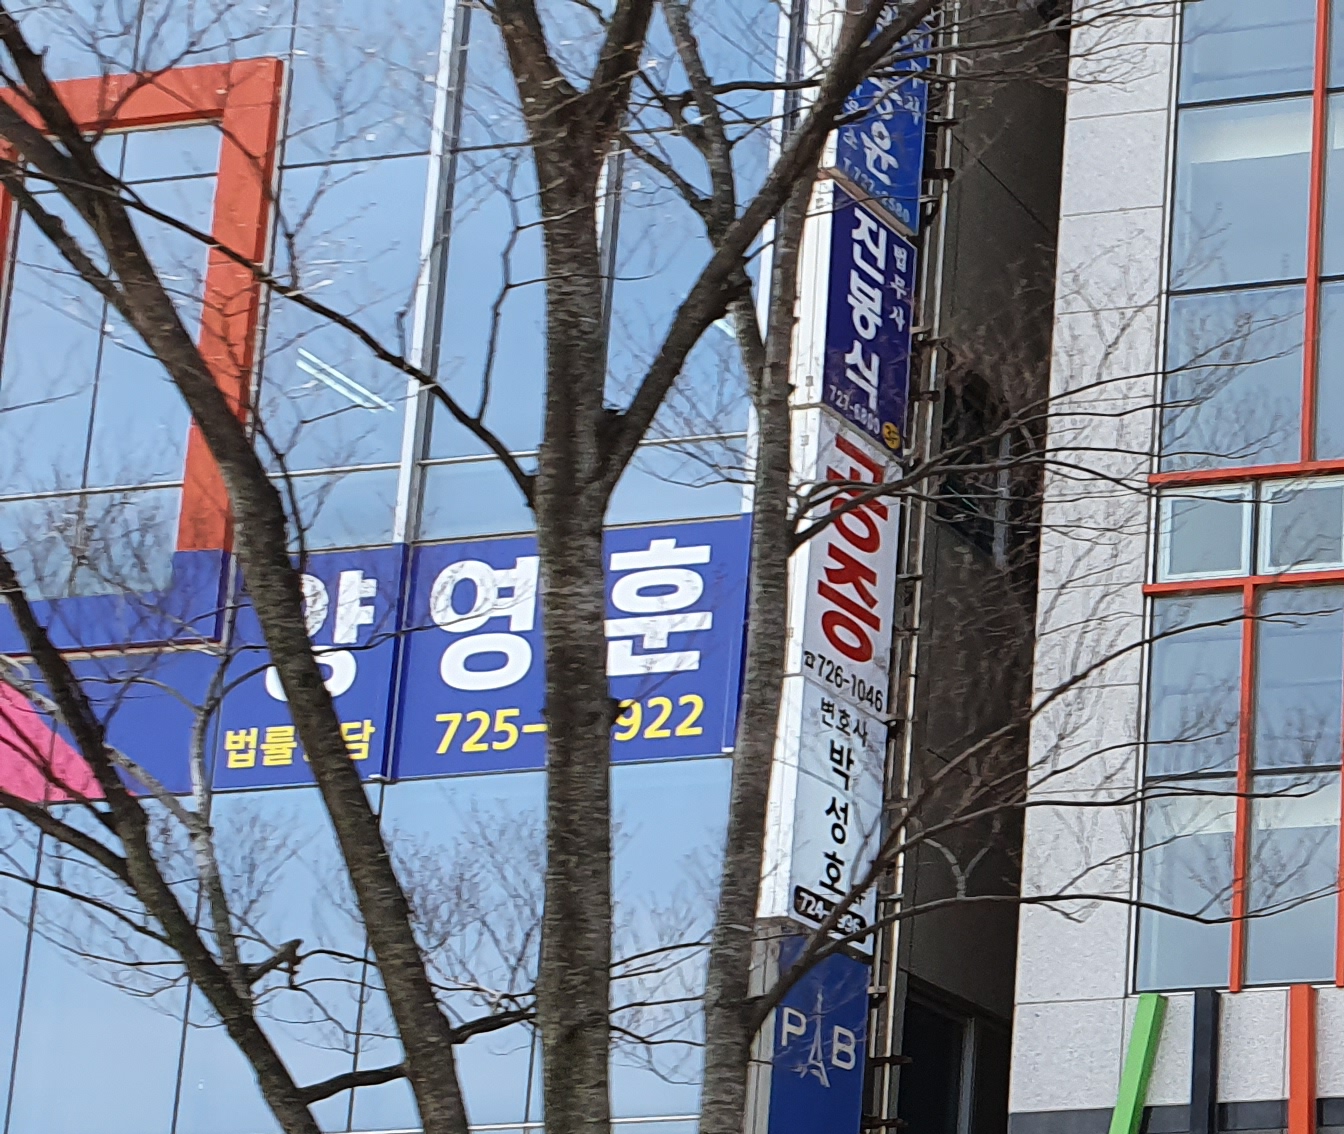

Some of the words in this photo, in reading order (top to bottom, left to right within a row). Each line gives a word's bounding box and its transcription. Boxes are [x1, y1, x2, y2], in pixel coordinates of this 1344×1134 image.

[844, 207, 887, 412] 진봉식
[889, 244, 908, 332] 법무사
[818, 433, 888, 663] 공증
[817, 654, 883, 713] 726-1046
[223, 719, 377, 770] 법률담
[436, 694, 704, 755] 725-922
[820, 697, 869, 747] 변호사
[819, 739, 855, 897] 박성호
